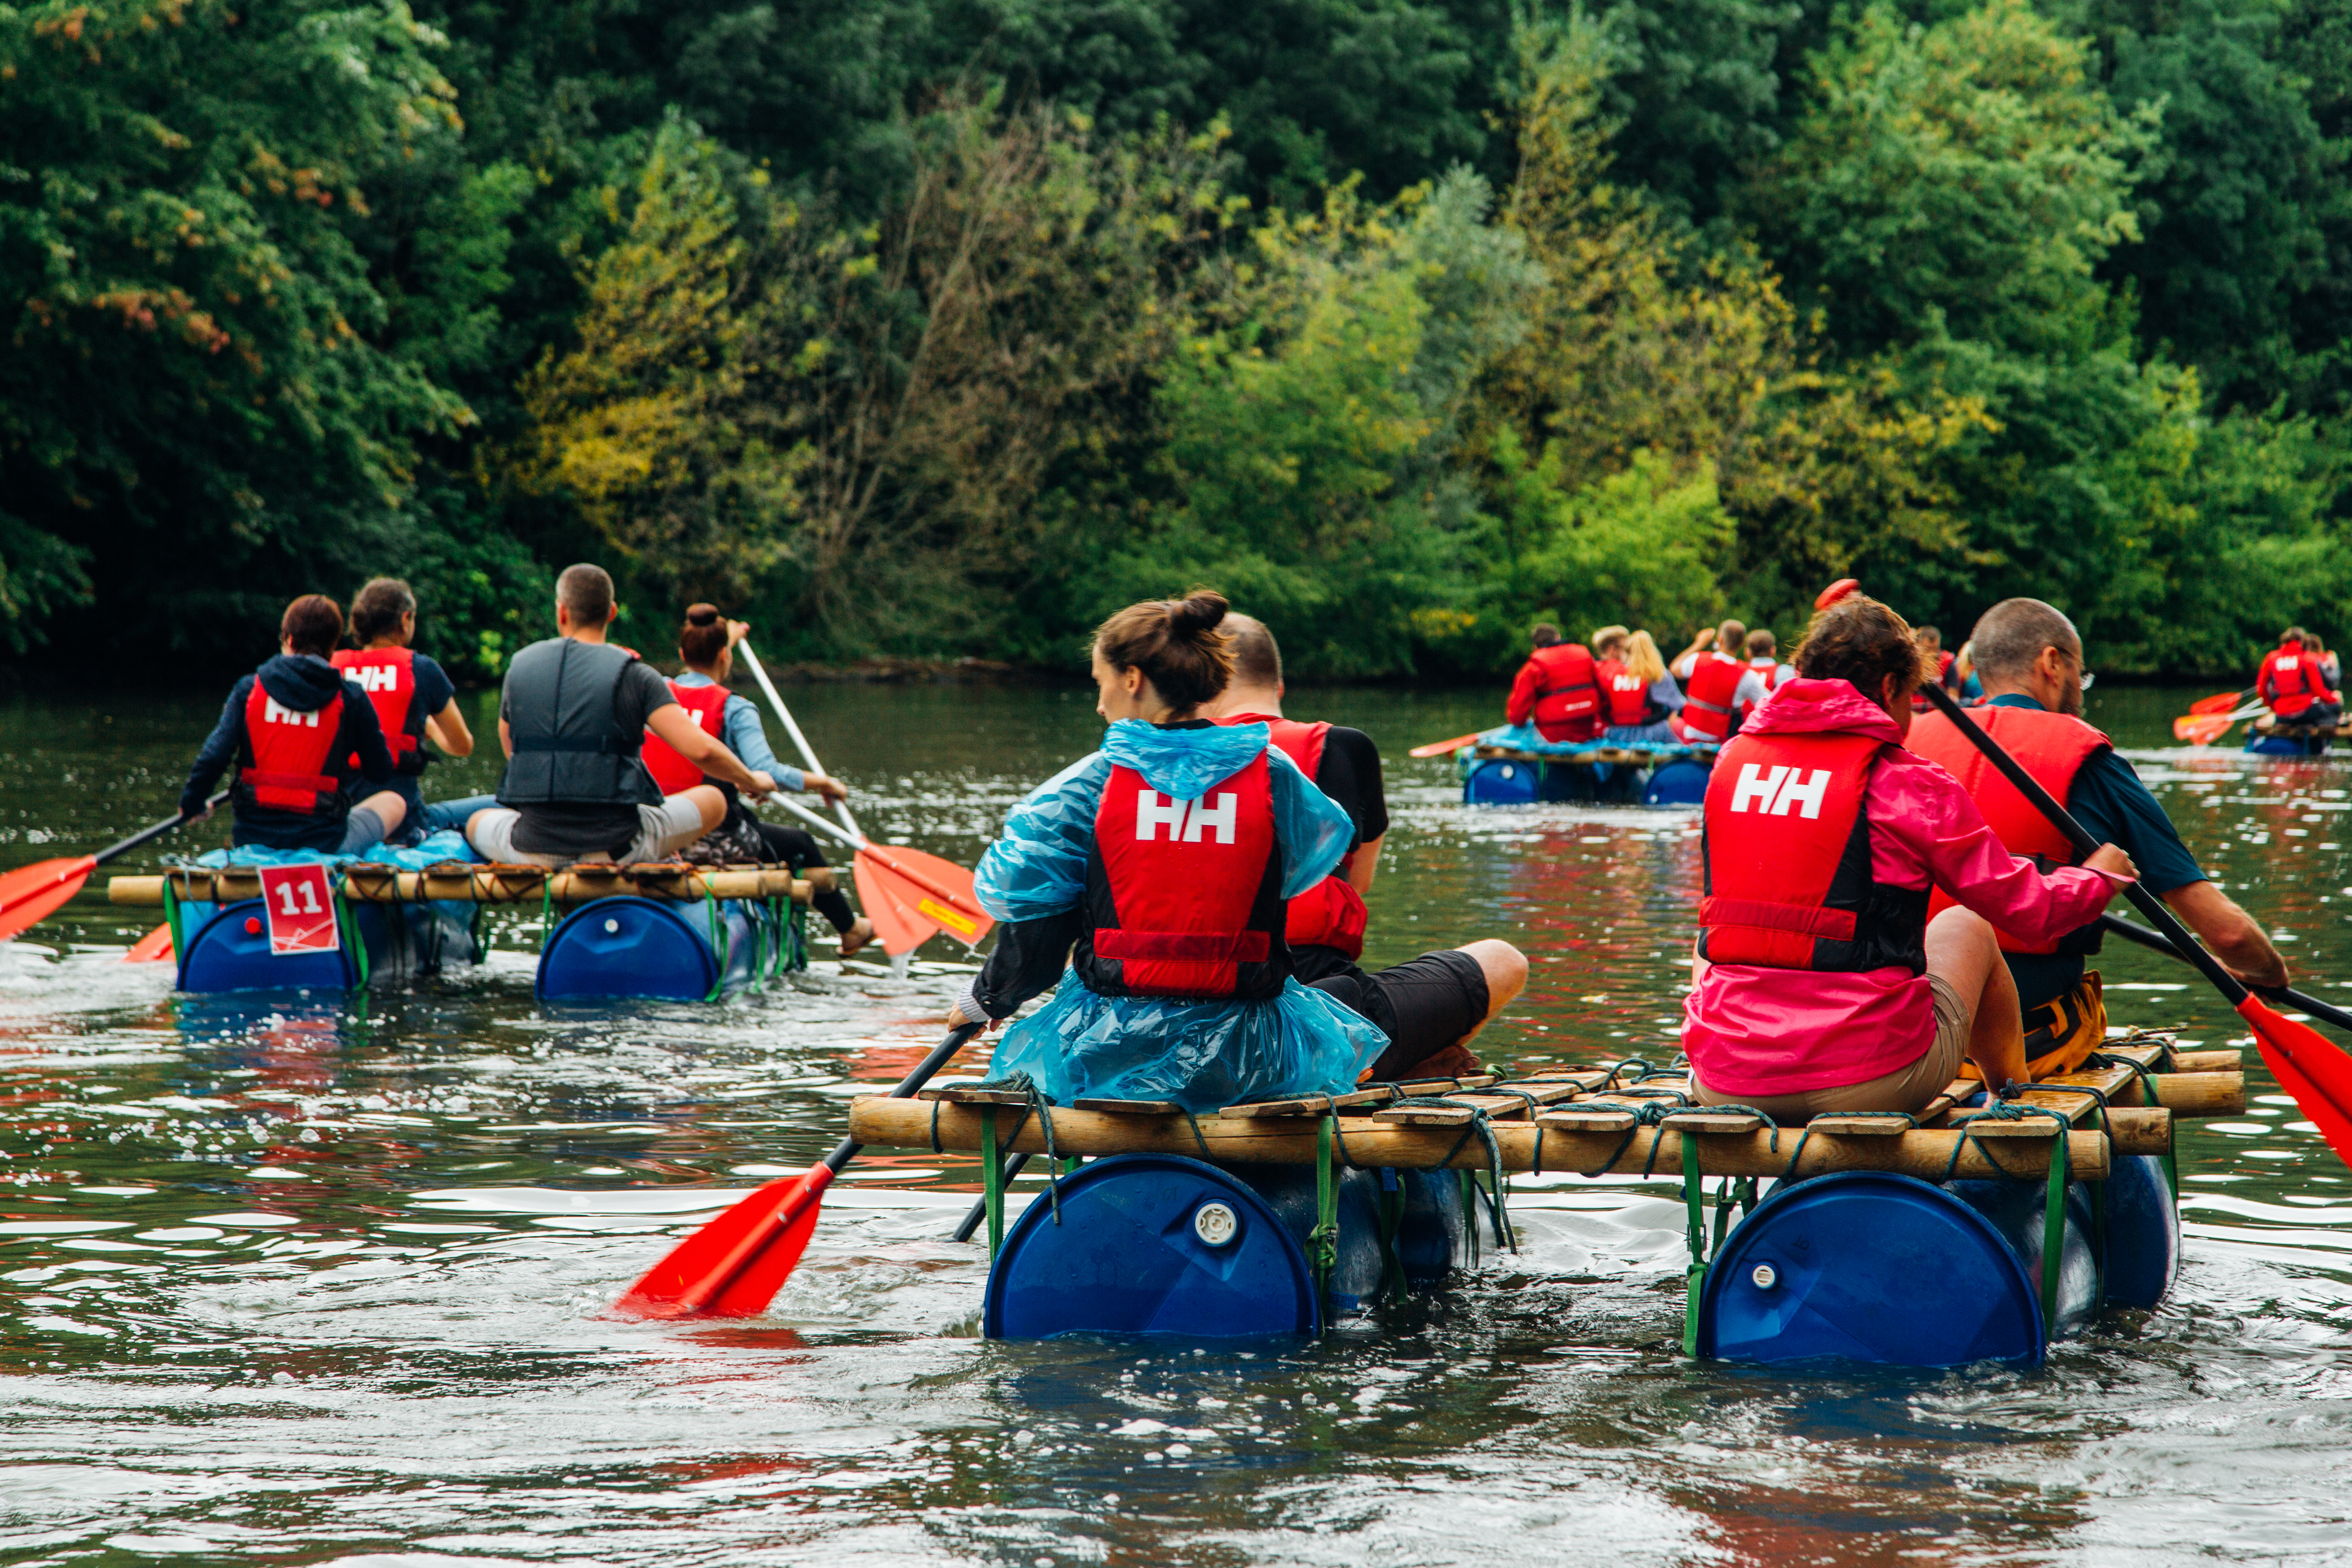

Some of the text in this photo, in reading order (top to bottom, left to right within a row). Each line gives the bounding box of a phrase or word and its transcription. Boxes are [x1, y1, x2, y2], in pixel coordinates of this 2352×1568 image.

[344, 665, 397, 692] HH
[1731, 764, 1832, 820] HH
[1136, 790, 1237, 844] HH
[276, 881, 322, 915] 11
